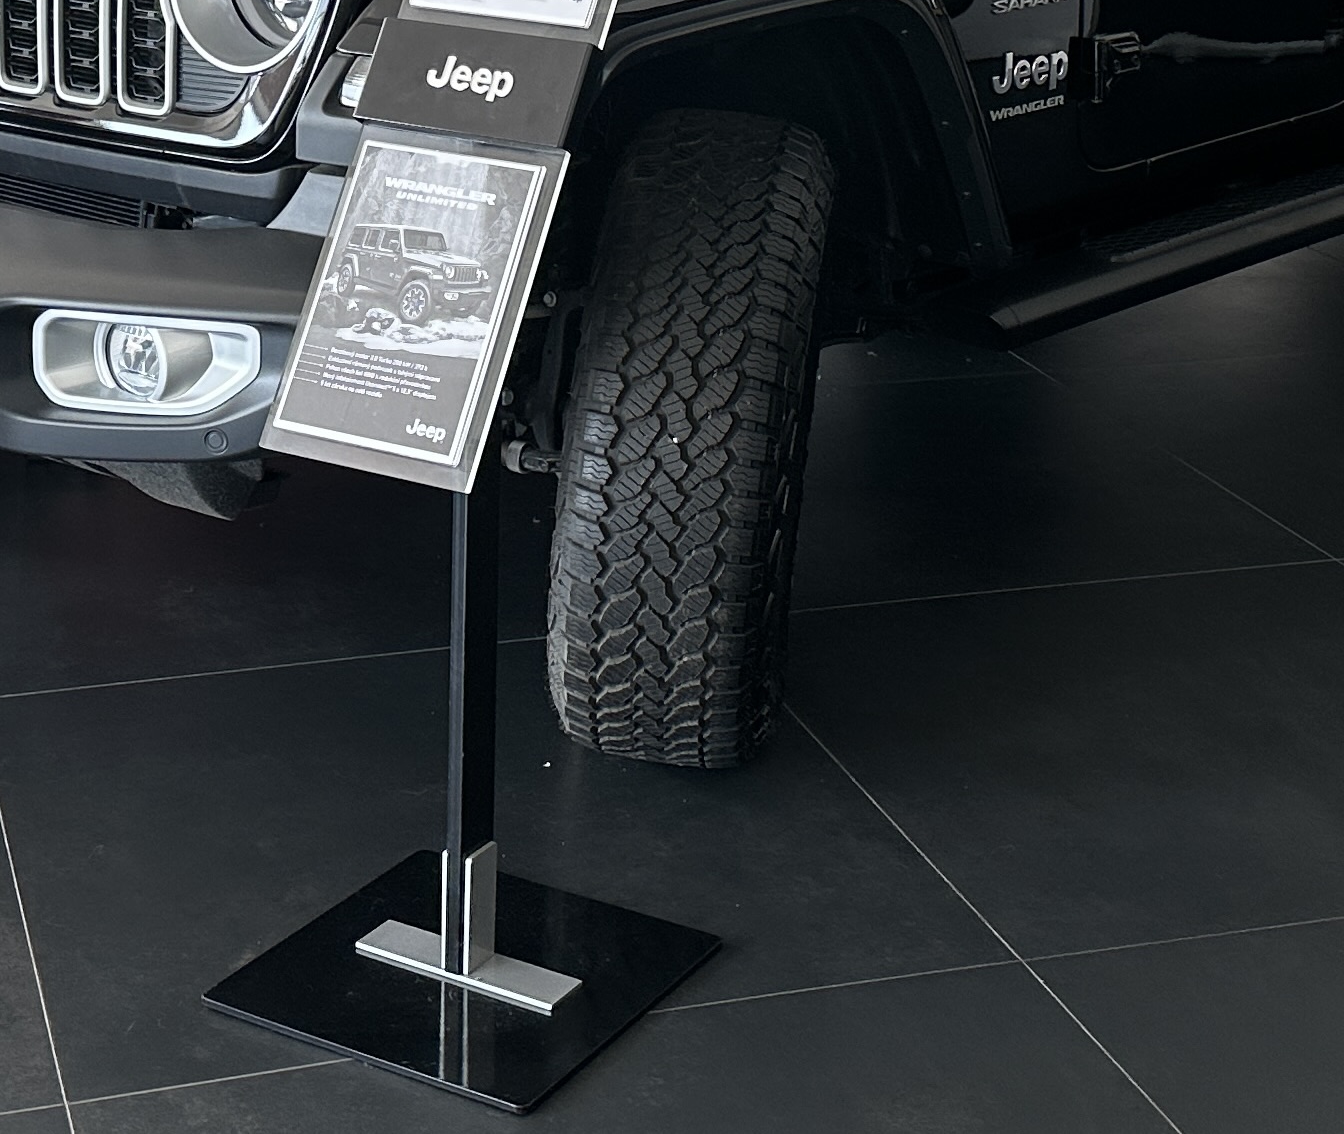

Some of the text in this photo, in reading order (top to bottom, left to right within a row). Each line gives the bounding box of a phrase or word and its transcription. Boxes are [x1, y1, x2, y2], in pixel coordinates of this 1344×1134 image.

[426, 55, 514, 103] Jeep
[991, 50, 1069, 95] Jeep
[989, 94, 1065, 122] WRANGLER
[385, 176, 497, 206] WRANGLER
[395, 191, 478, 211] UNLIMITED
[405, 418, 446, 444] Jeep
